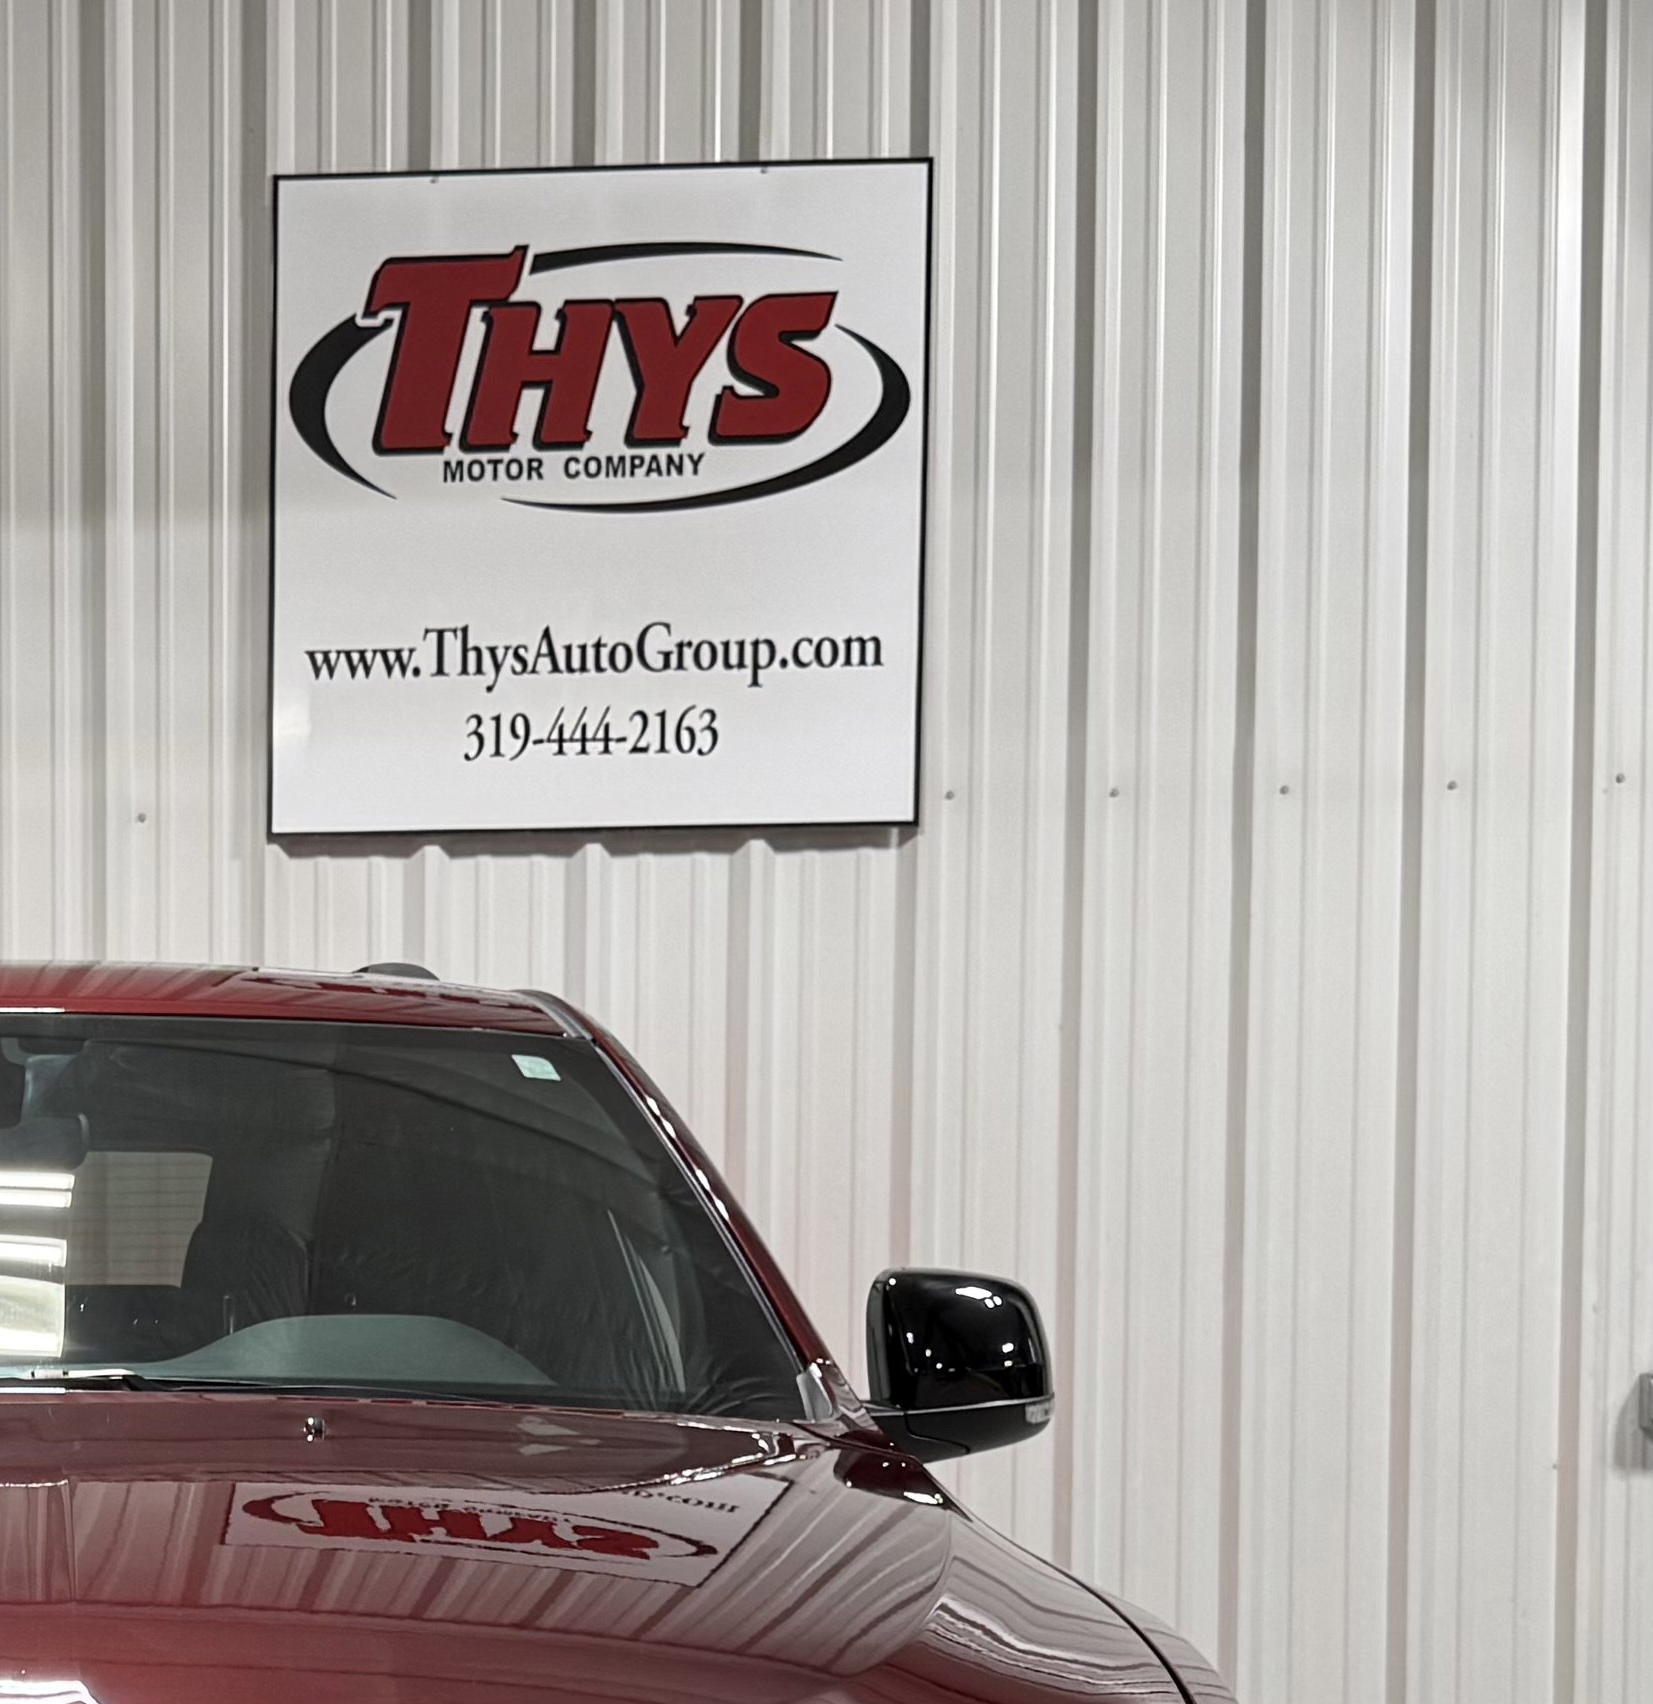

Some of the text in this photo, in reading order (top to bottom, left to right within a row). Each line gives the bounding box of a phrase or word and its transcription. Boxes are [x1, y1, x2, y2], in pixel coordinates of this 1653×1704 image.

[362, 244, 840, 456] THYS
[442, 452, 706, 484] MOTOR COMPANY
[305, 621, 885, 693] www.ThysAutoGroup.com
[462, 704, 721, 762] 319-444-2163
